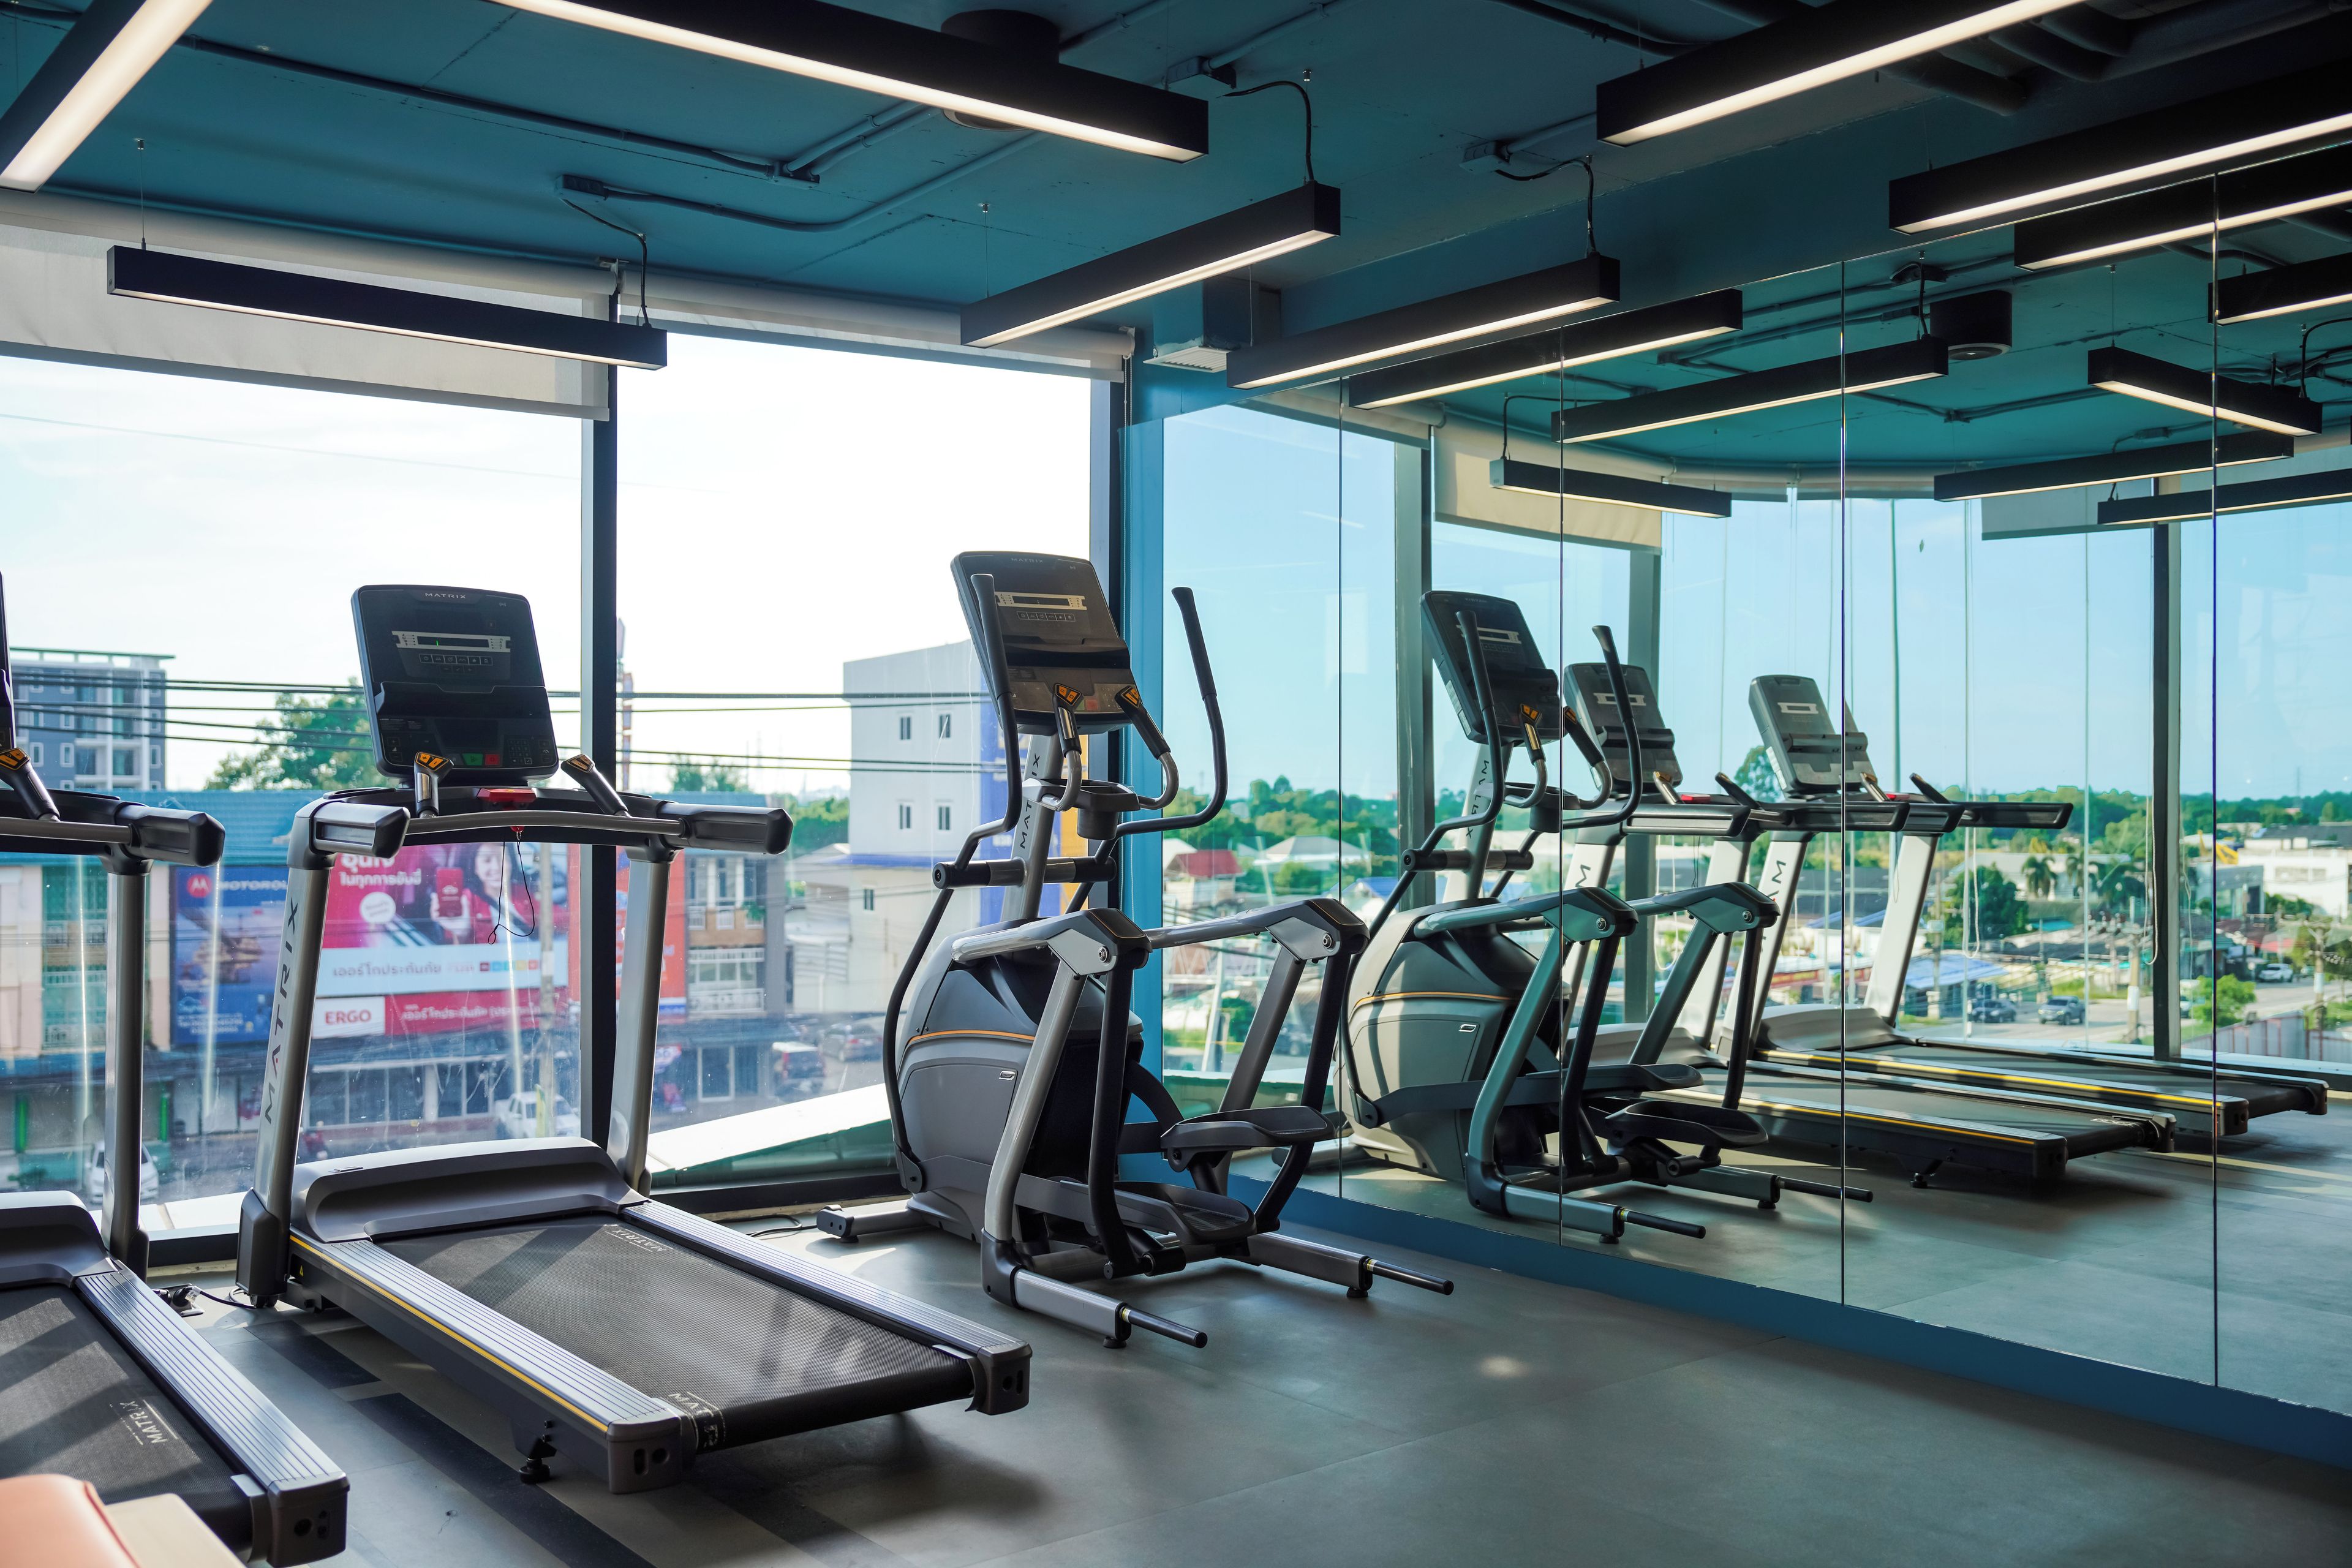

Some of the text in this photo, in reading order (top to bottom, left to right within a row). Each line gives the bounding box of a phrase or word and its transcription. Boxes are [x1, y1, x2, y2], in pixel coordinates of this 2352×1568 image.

[1020, 753, 1040, 849] MATIX
[217, 880, 288, 891] MOTOROL
[265, 897, 298, 1124] MATRIX
[325, 1009, 371, 1025] ERGO
[612, 1229, 666, 1251] MATRIX
[119, 1400, 168, 1444] MATRIX
